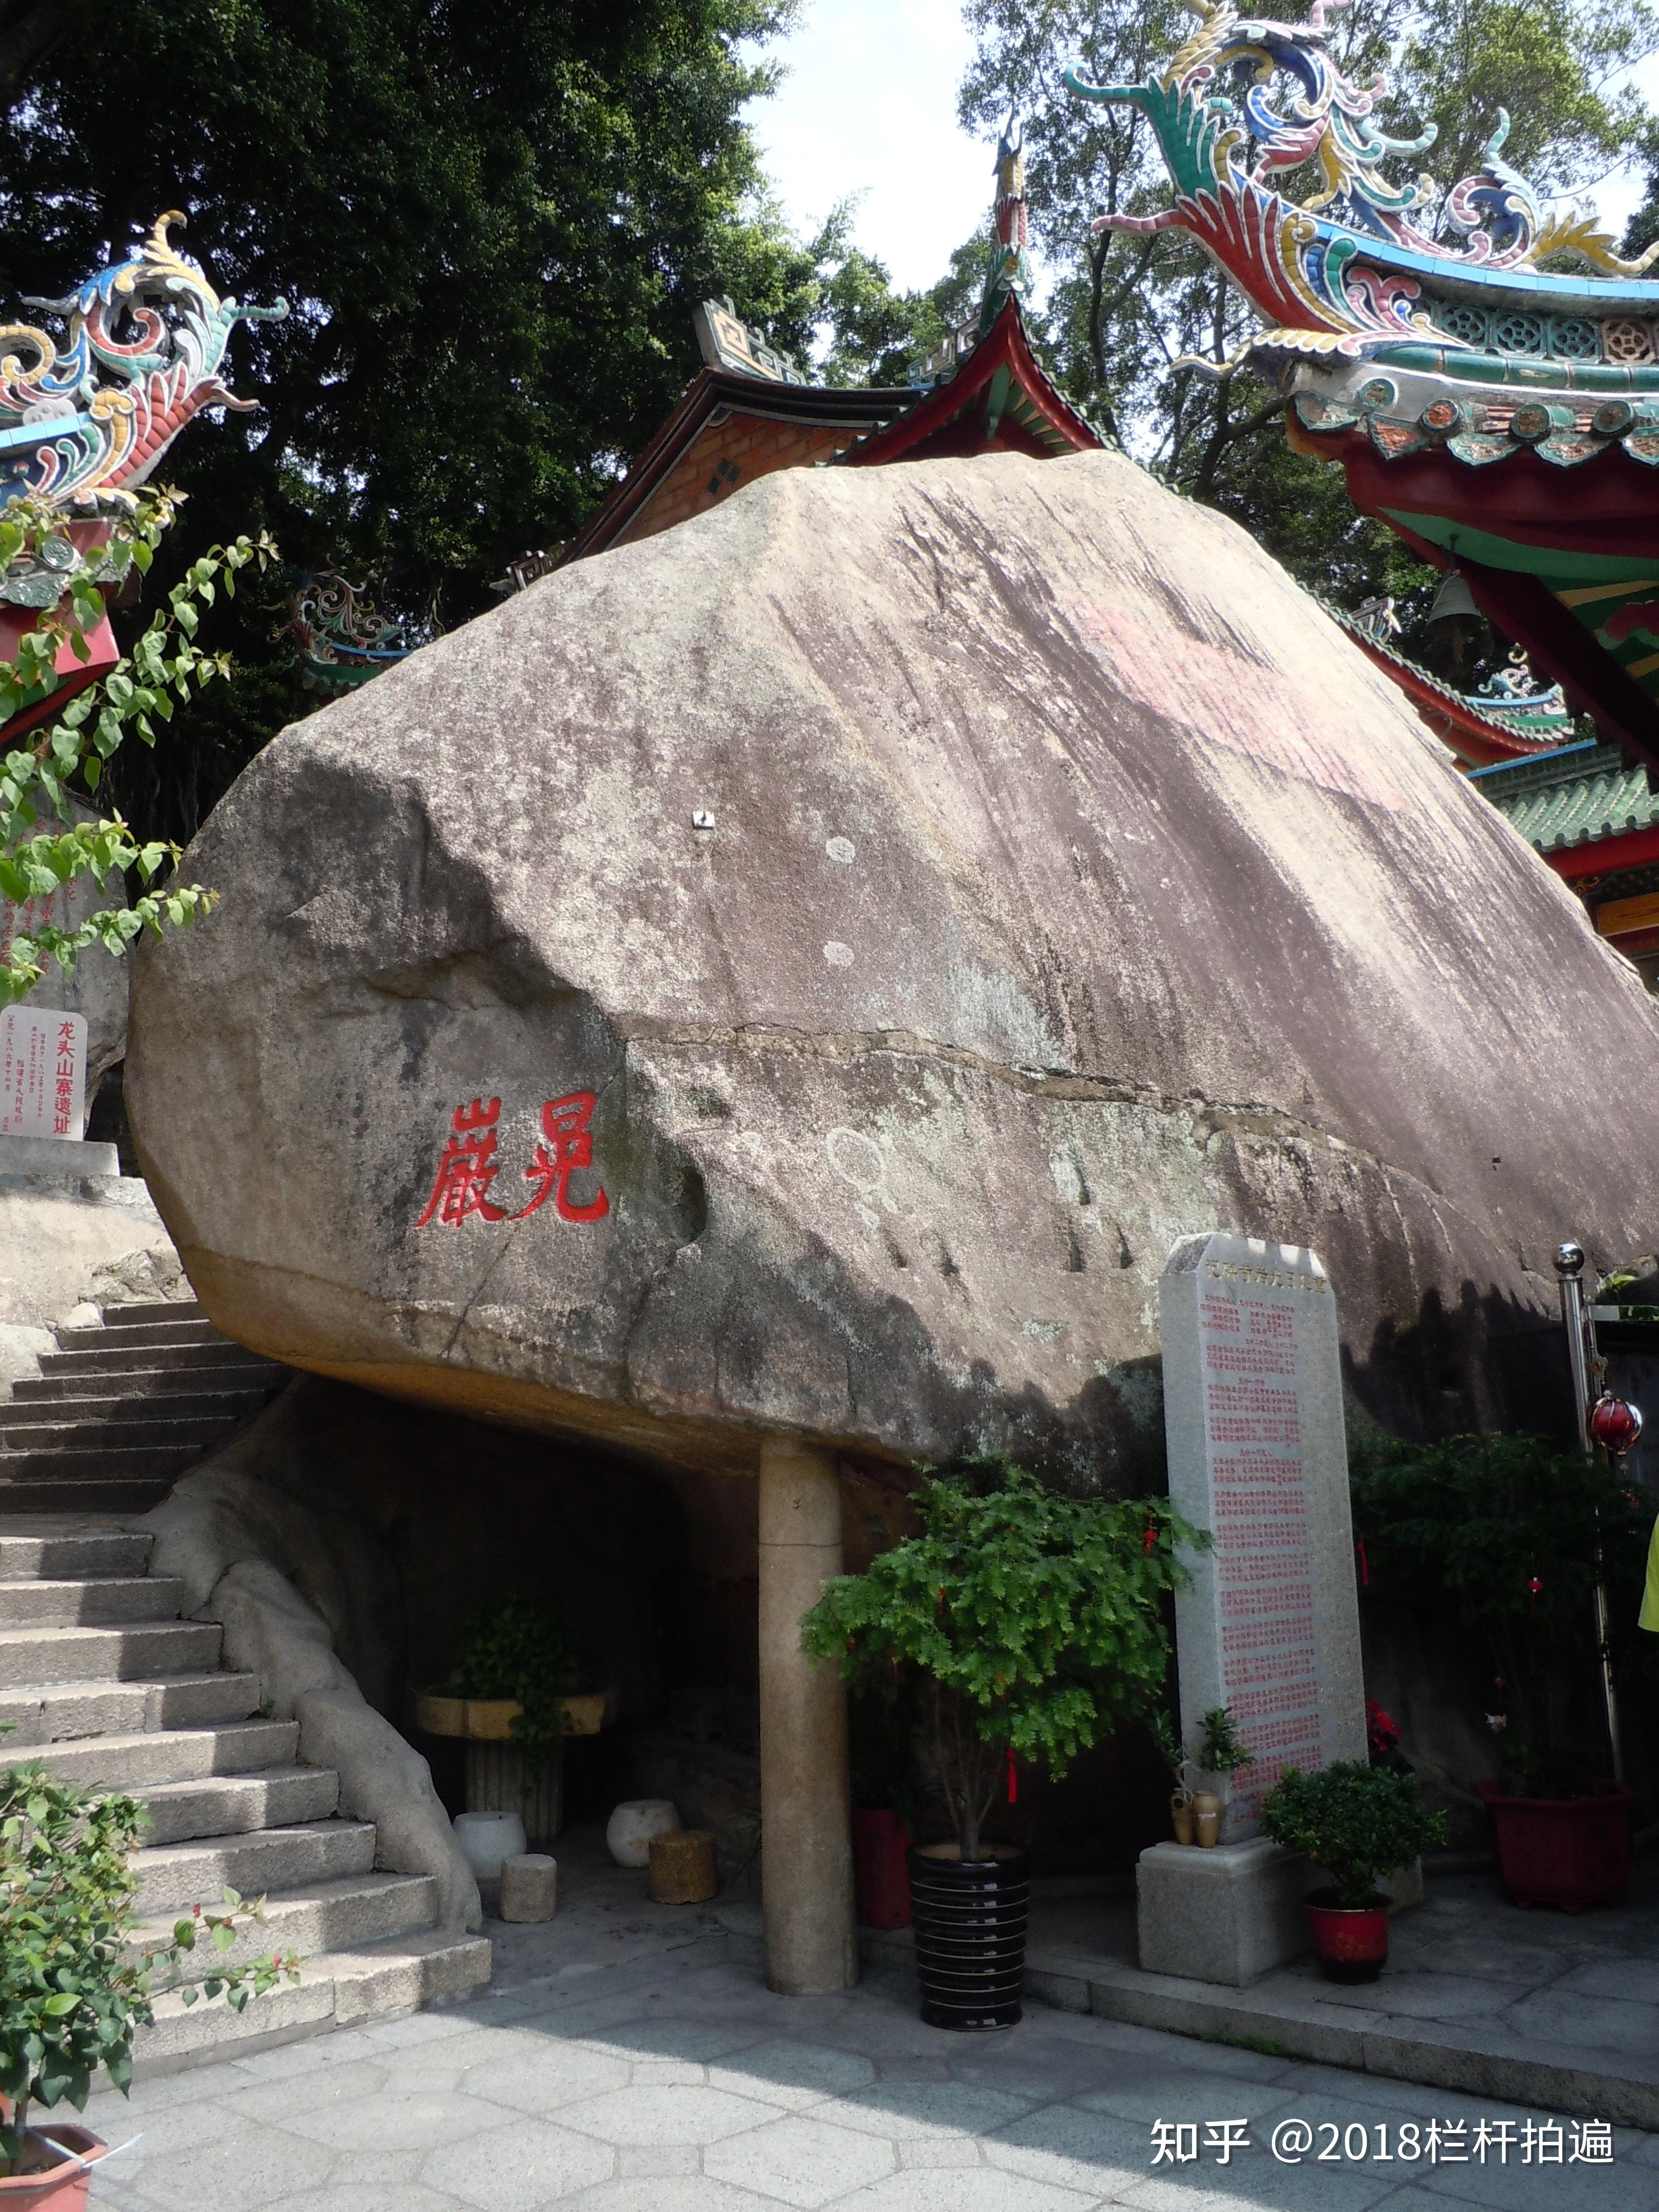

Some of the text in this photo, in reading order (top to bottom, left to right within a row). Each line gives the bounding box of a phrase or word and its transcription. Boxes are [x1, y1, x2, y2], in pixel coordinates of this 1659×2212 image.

[15, 1059, 25, 1123] 福建省人民政府
[54, 1020, 76, 1134] 龙头山寨遗址
